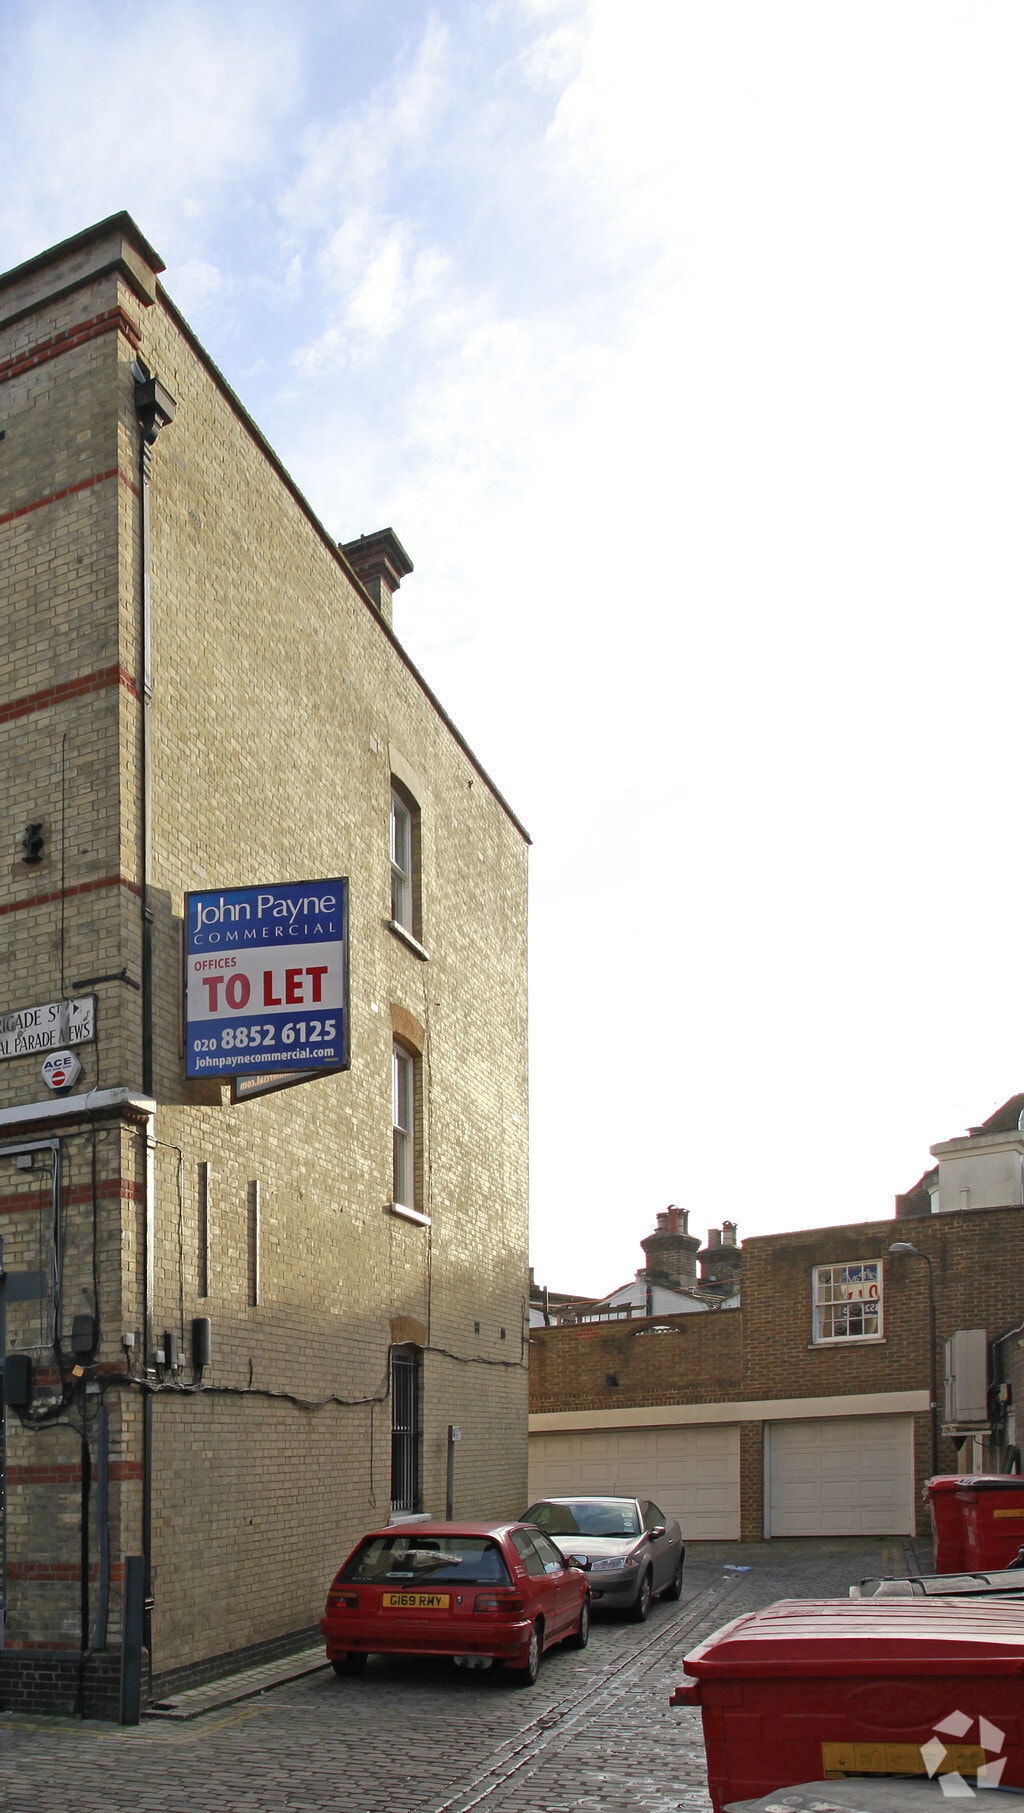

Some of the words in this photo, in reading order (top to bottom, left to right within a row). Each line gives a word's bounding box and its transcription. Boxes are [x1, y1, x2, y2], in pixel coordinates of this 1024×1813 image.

[193, 897, 251, 934] John
[257, 894, 336, 924] Payne
[193, 921, 336, 945] COMMERCIAL
[194, 957, 237, 972] OFFICES
[202, 973, 251, 1012] TO
[263, 965, 328, 1007] LET
[14, 1029, 57, 1052] PARADE
[193, 1038, 217, 1052] 020
[221, 1024, 276, 1050] 8852
[281, 1019, 336, 1044] 6125
[43, 1056, 72, 1069] ACE
[195, 1047, 335, 1070] johnpaynecommercial.com
[390, 1594, 416, 1606] G169
